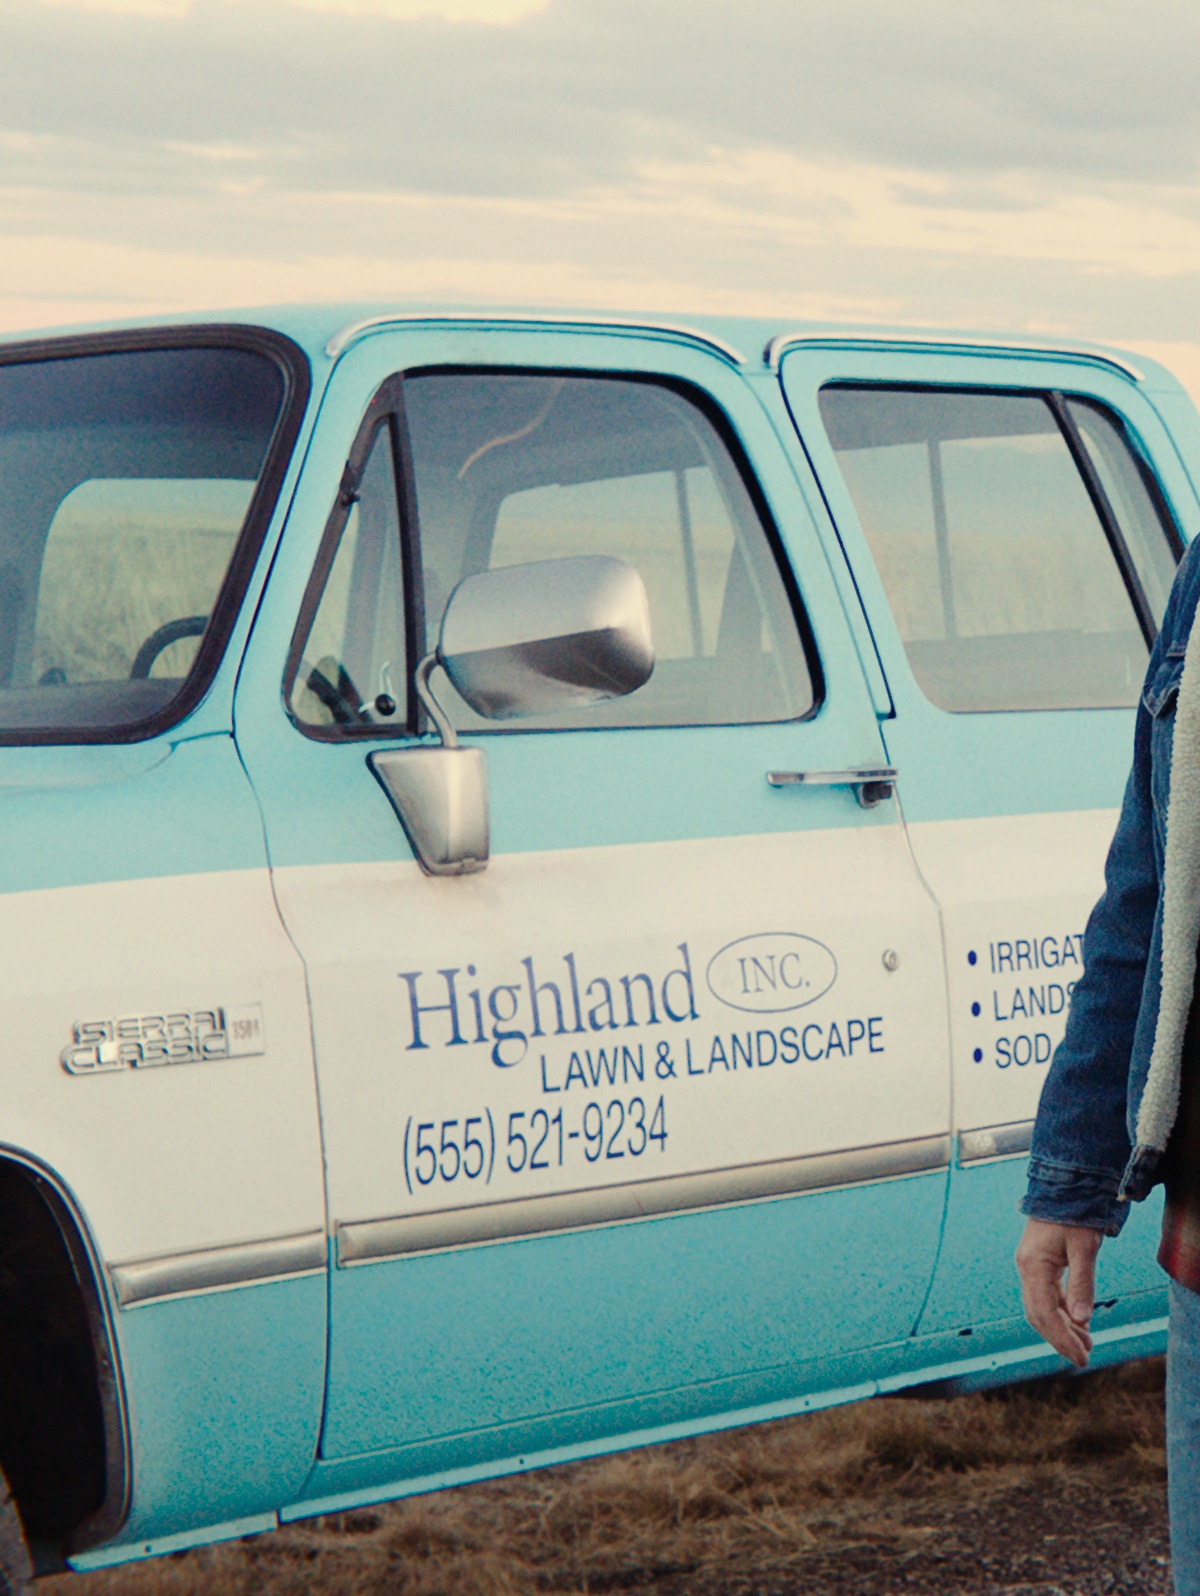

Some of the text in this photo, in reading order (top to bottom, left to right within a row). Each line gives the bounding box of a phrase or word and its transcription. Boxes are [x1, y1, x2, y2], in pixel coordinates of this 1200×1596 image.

[80, 1010, 218, 1044] SIERRA
[398, 943, 811, 1068] Highland INC.
[70, 1033, 227, 1069] CLASSIC
[541, 1017, 886, 1093] LAWN & LANDSCAPE
[995, 1033, 1052, 1069] SOD
[403, 1095, 669, 1196] (555) 521-9234
